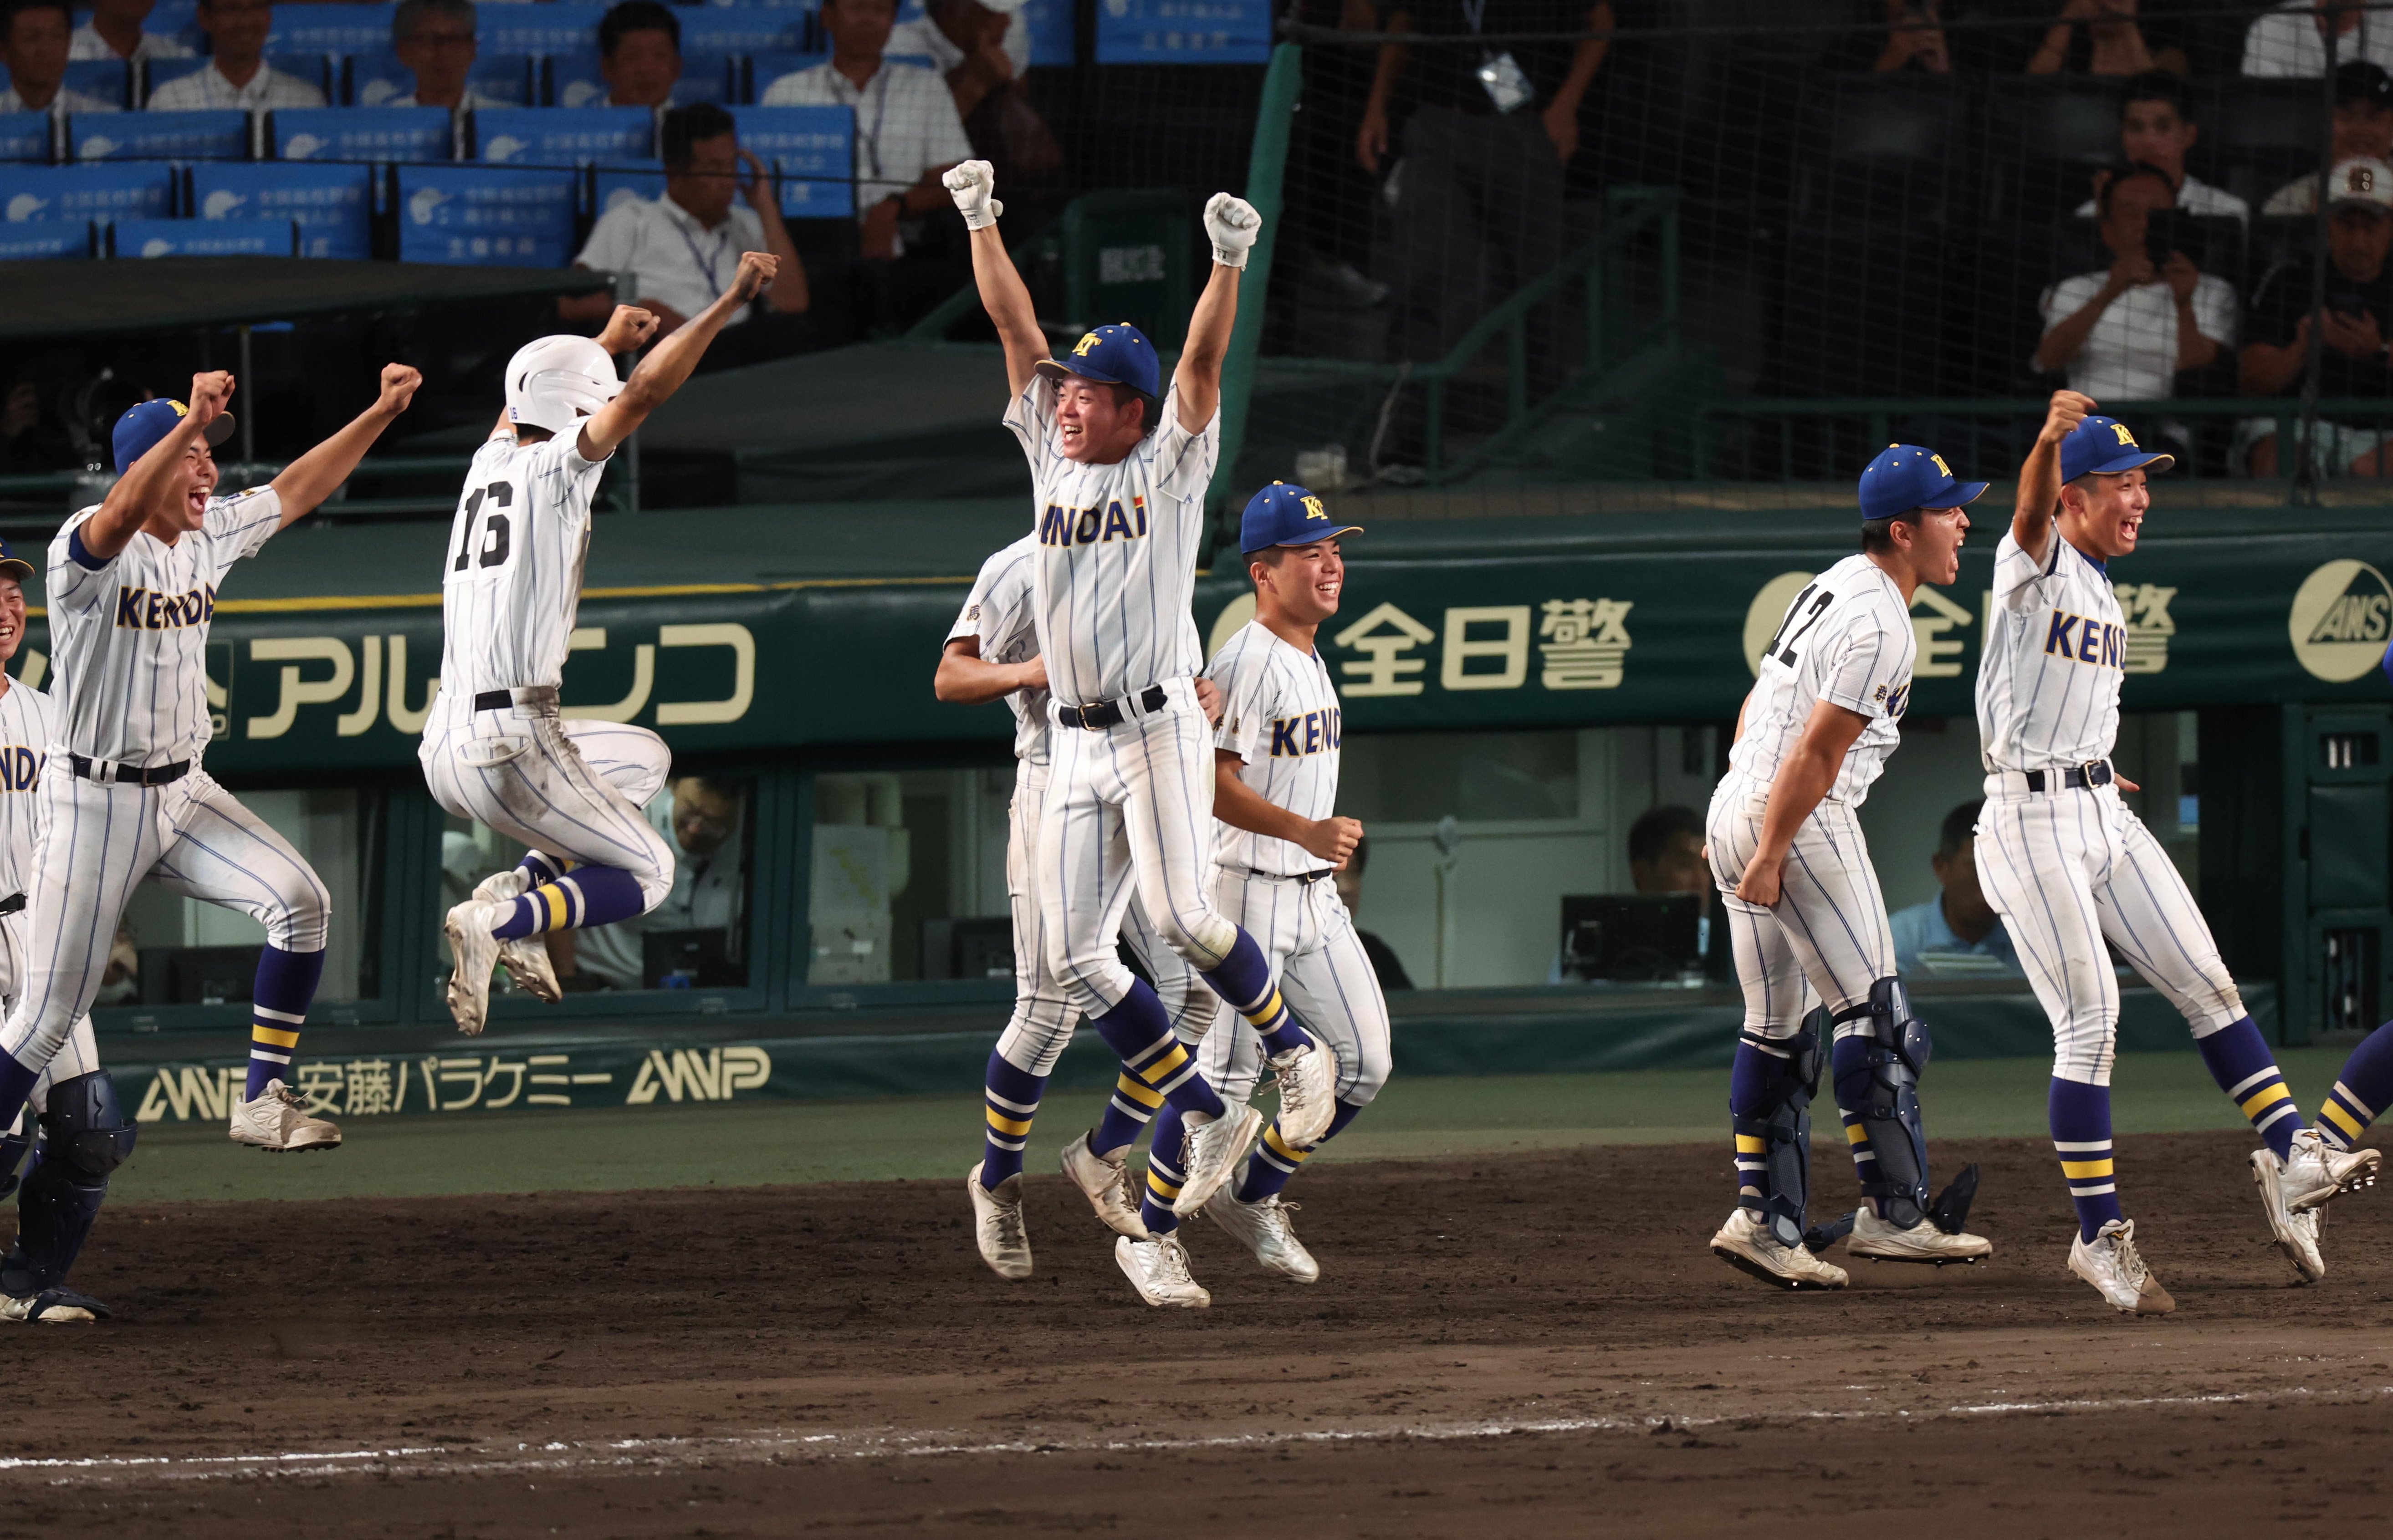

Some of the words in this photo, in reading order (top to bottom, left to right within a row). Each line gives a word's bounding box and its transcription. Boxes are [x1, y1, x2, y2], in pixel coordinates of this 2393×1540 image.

[510, 407, 518, 419] 16
[455, 481, 513, 572] 16
[1334, 597, 1633, 697] 全日警
[1761, 583, 1835, 668] 12
[2312, 594, 2390, 641] ANS
[297, 1055, 613, 1116] 安藤パラケミー
[626, 1045, 772, 1105] ANP
